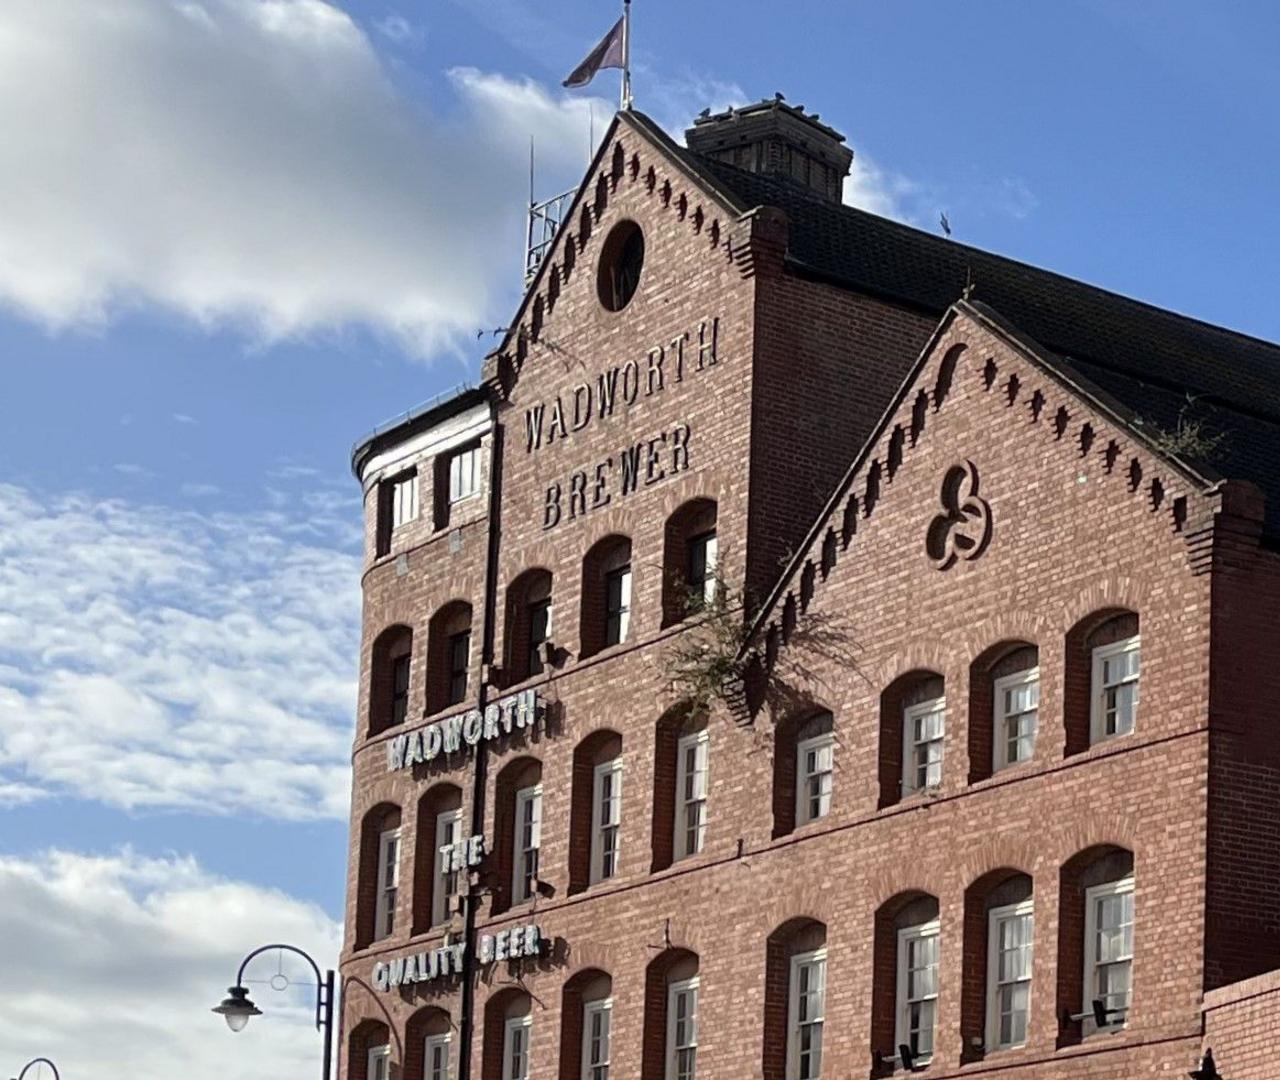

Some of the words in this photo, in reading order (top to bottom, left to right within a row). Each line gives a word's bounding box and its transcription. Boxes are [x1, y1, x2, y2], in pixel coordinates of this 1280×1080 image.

[525, 317, 720, 454] WADWORTH
[542, 423, 691, 531] BREWER
[386, 689, 537, 772] WADWORTH
[439, 834, 484, 874] THE
[371, 942, 467, 993] QUALITY
[479, 924, 540, 965] BEER
